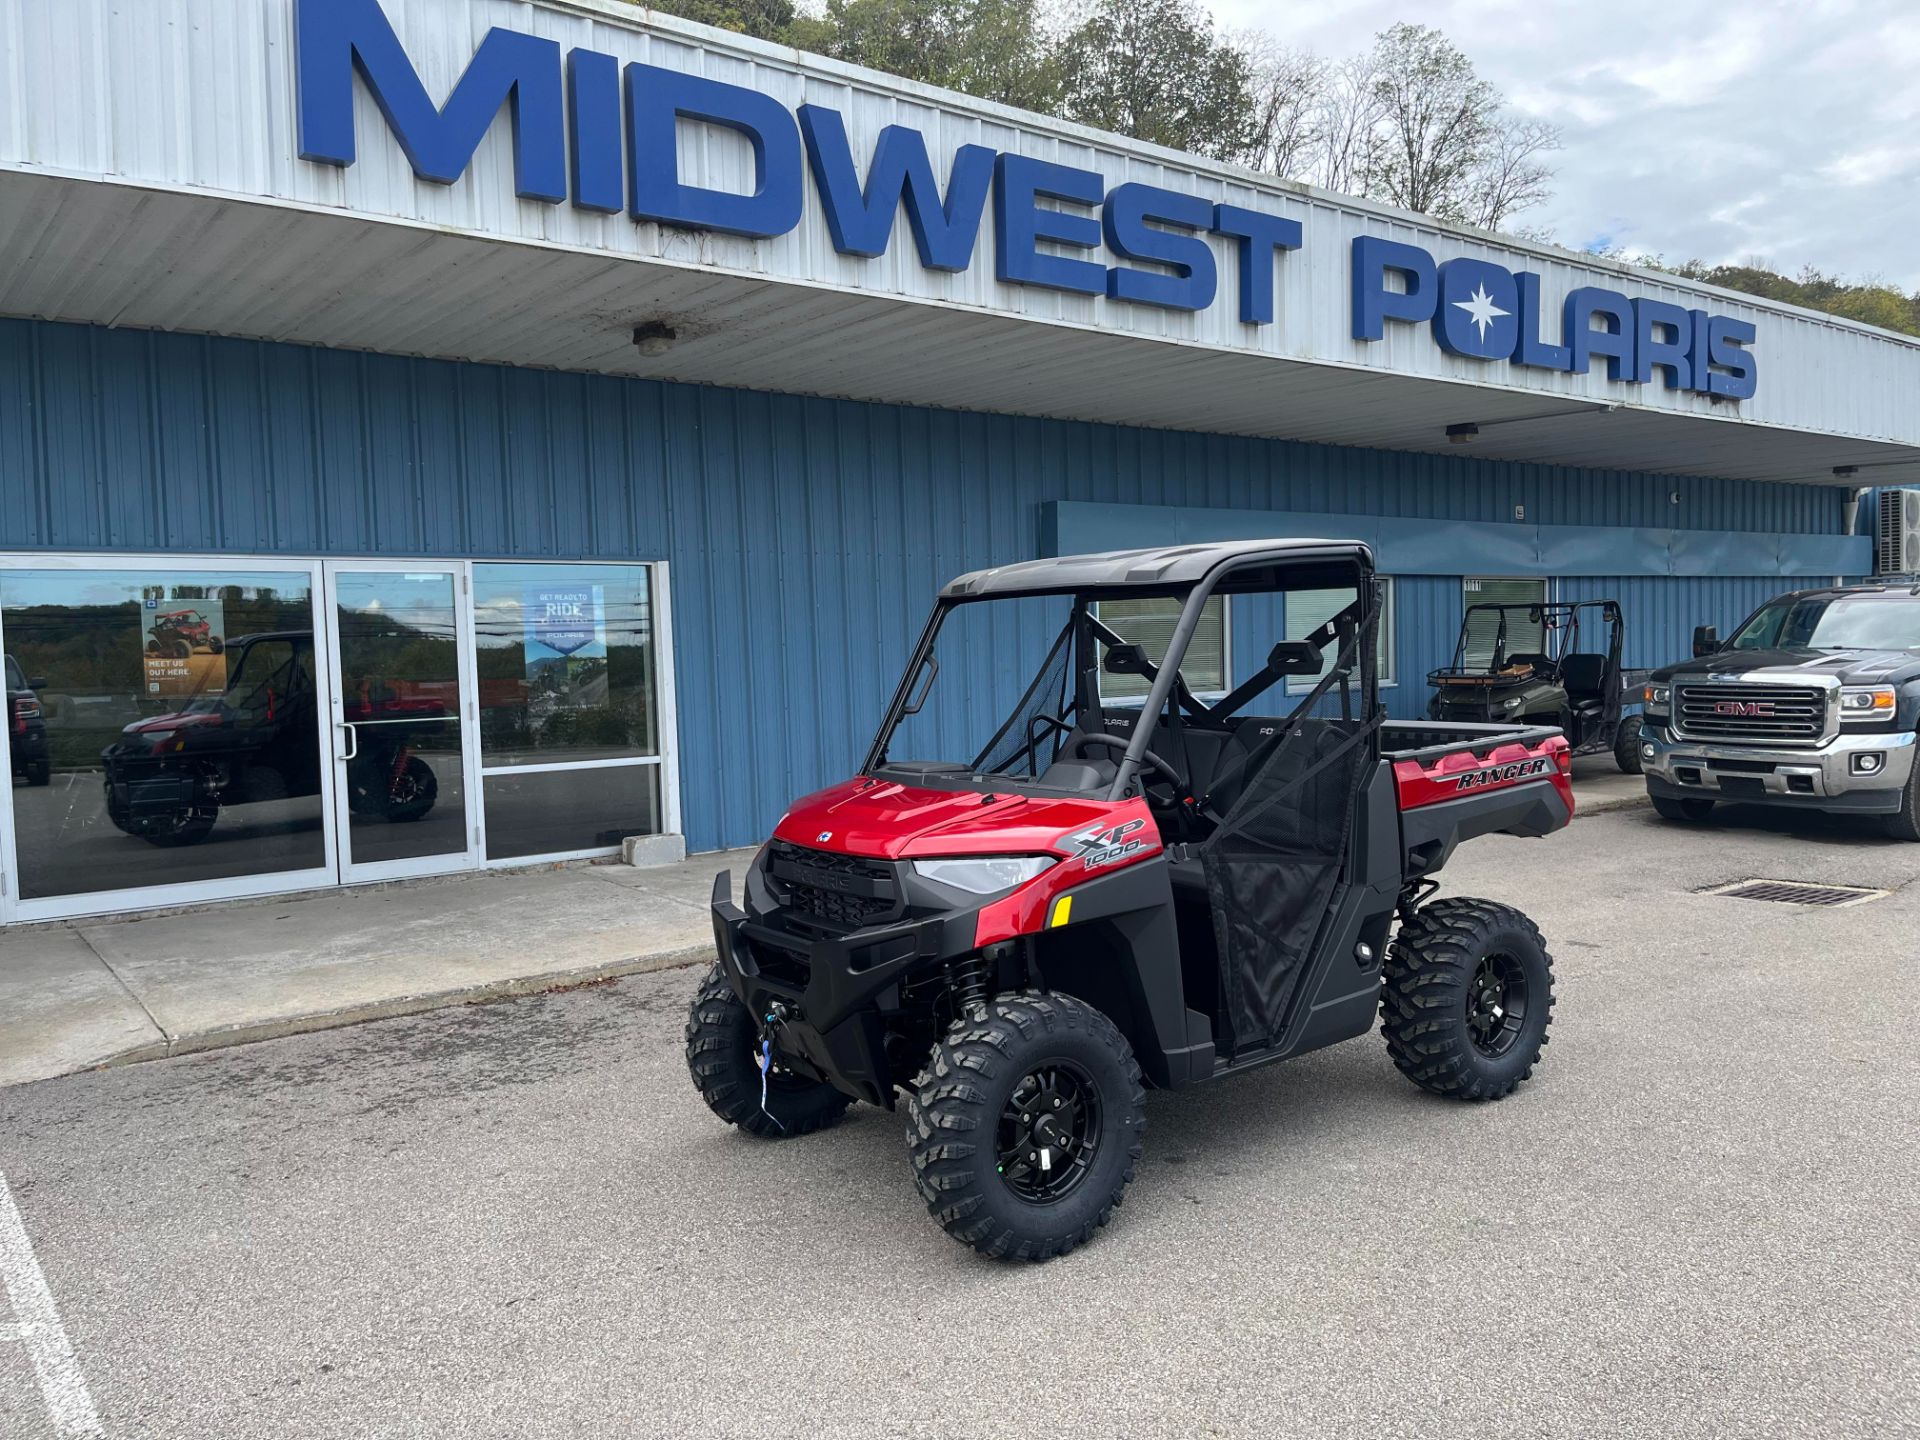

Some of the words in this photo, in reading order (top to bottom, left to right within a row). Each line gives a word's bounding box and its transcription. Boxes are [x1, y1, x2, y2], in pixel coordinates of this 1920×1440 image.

[294, 0, 1303, 326] MIDWEST
[1352, 235, 1757, 400] POLARIS
[546, 602, 582, 617] RIDE
[1103, 718, 1130, 727] OLARIS
[1714, 701, 1775, 717] GMC
[1456, 759, 1546, 791] RANGER
[1067, 818, 1146, 863] XP
[1084, 839, 1141, 868] 1000
